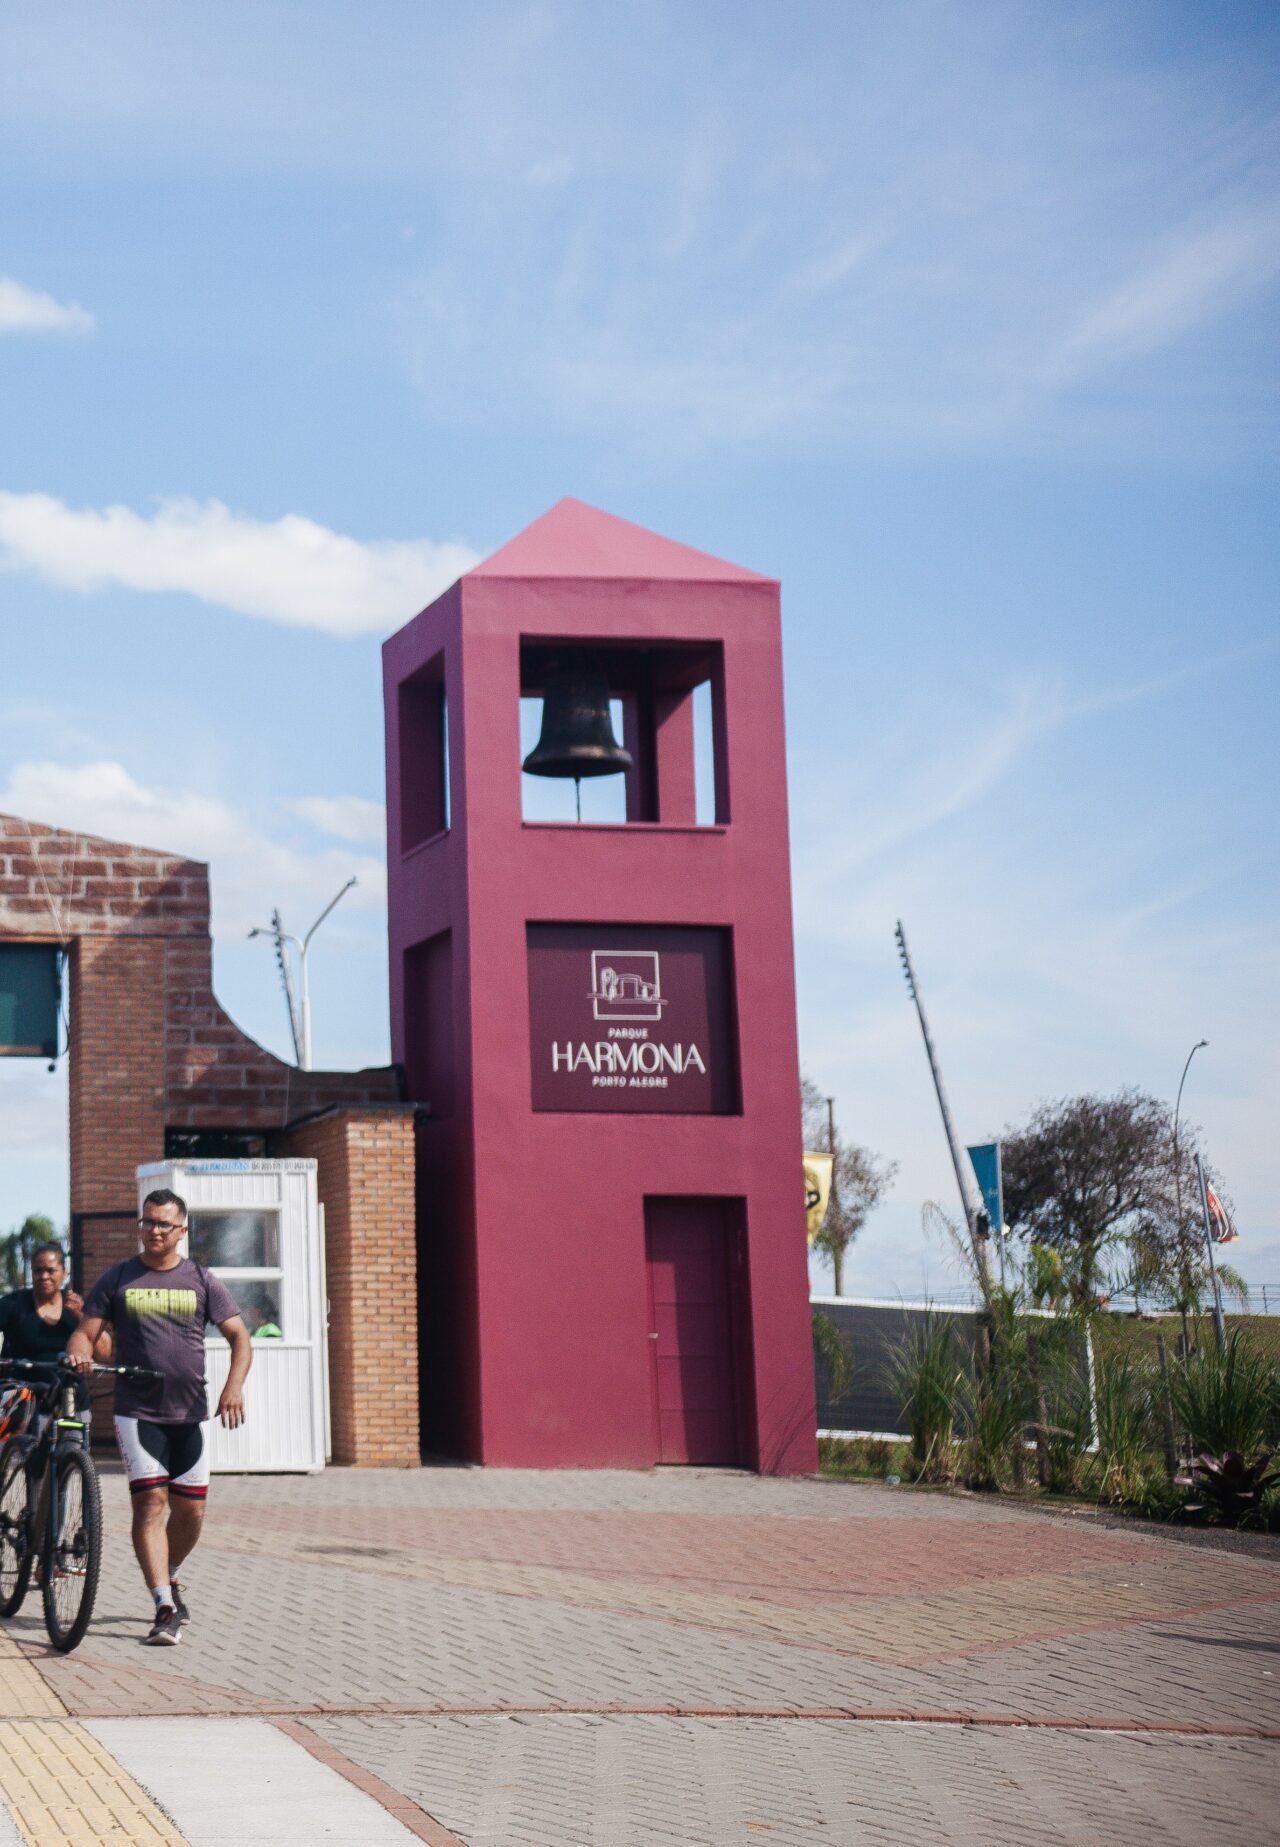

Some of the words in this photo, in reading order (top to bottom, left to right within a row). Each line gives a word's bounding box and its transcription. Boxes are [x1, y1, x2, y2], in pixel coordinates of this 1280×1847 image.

[608, 1028, 648, 1039] PARQUE
[552, 1041, 706, 1074] HARMONIA
[592, 1076, 627, 1088] PORTO
[629, 1077, 669, 1088] ALEGRE
